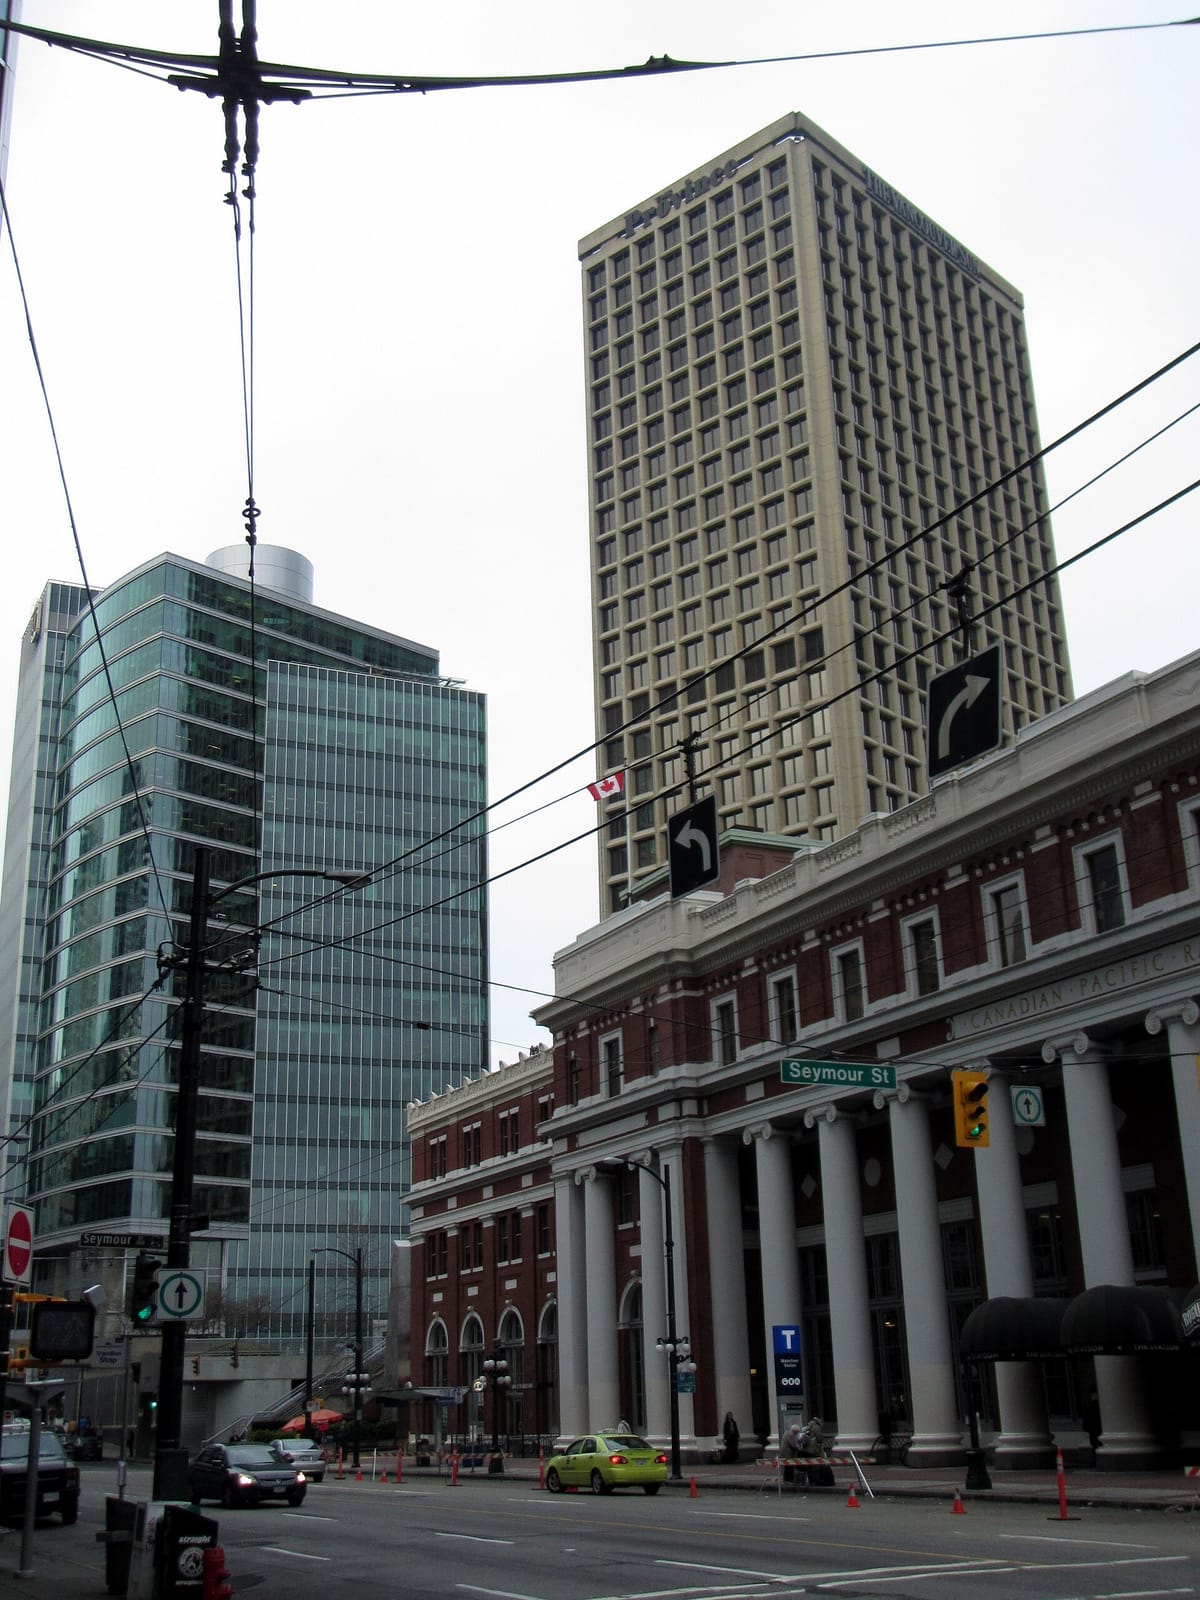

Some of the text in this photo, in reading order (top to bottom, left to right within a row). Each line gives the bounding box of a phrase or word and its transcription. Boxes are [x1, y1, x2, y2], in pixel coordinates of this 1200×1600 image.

[623, 158, 738, 240] Province
[970, 943, 1200, 1029] CANADIAN PACIFIC R
[789, 1061, 889, 1084] Seymour St
[83, 1233, 133, 1248] Seymour
[781, 1329, 796, 1350] T
